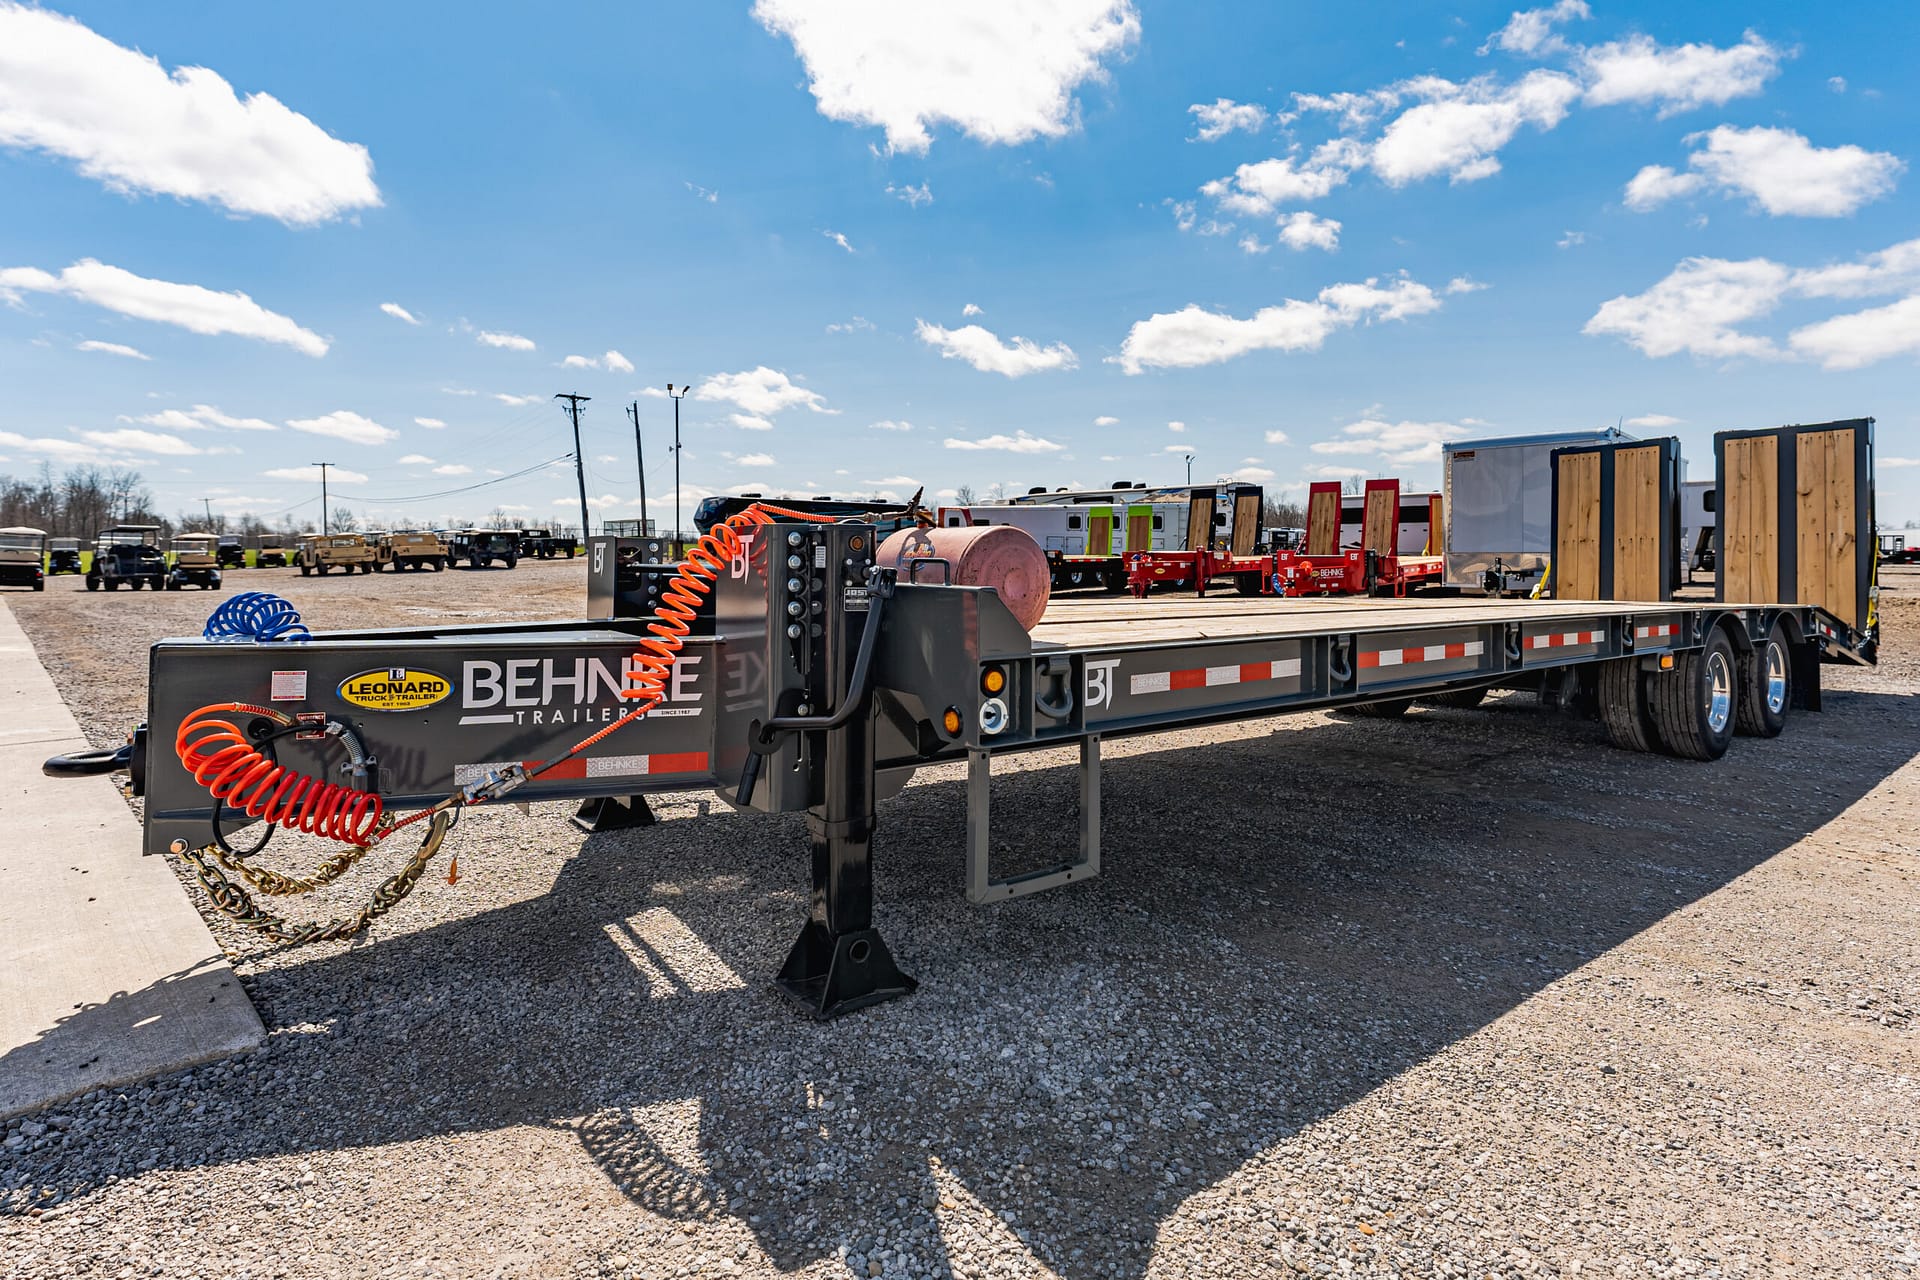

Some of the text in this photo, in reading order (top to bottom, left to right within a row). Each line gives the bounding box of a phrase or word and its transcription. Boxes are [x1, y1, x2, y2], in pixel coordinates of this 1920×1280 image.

[594, 542, 606, 576] BT
[1320, 568, 1344, 577] BEHNKE
[348, 682, 444, 695] LEONARD
[1085, 658, 1121, 711] BT
[598, 760, 638, 770] BEHNKE
